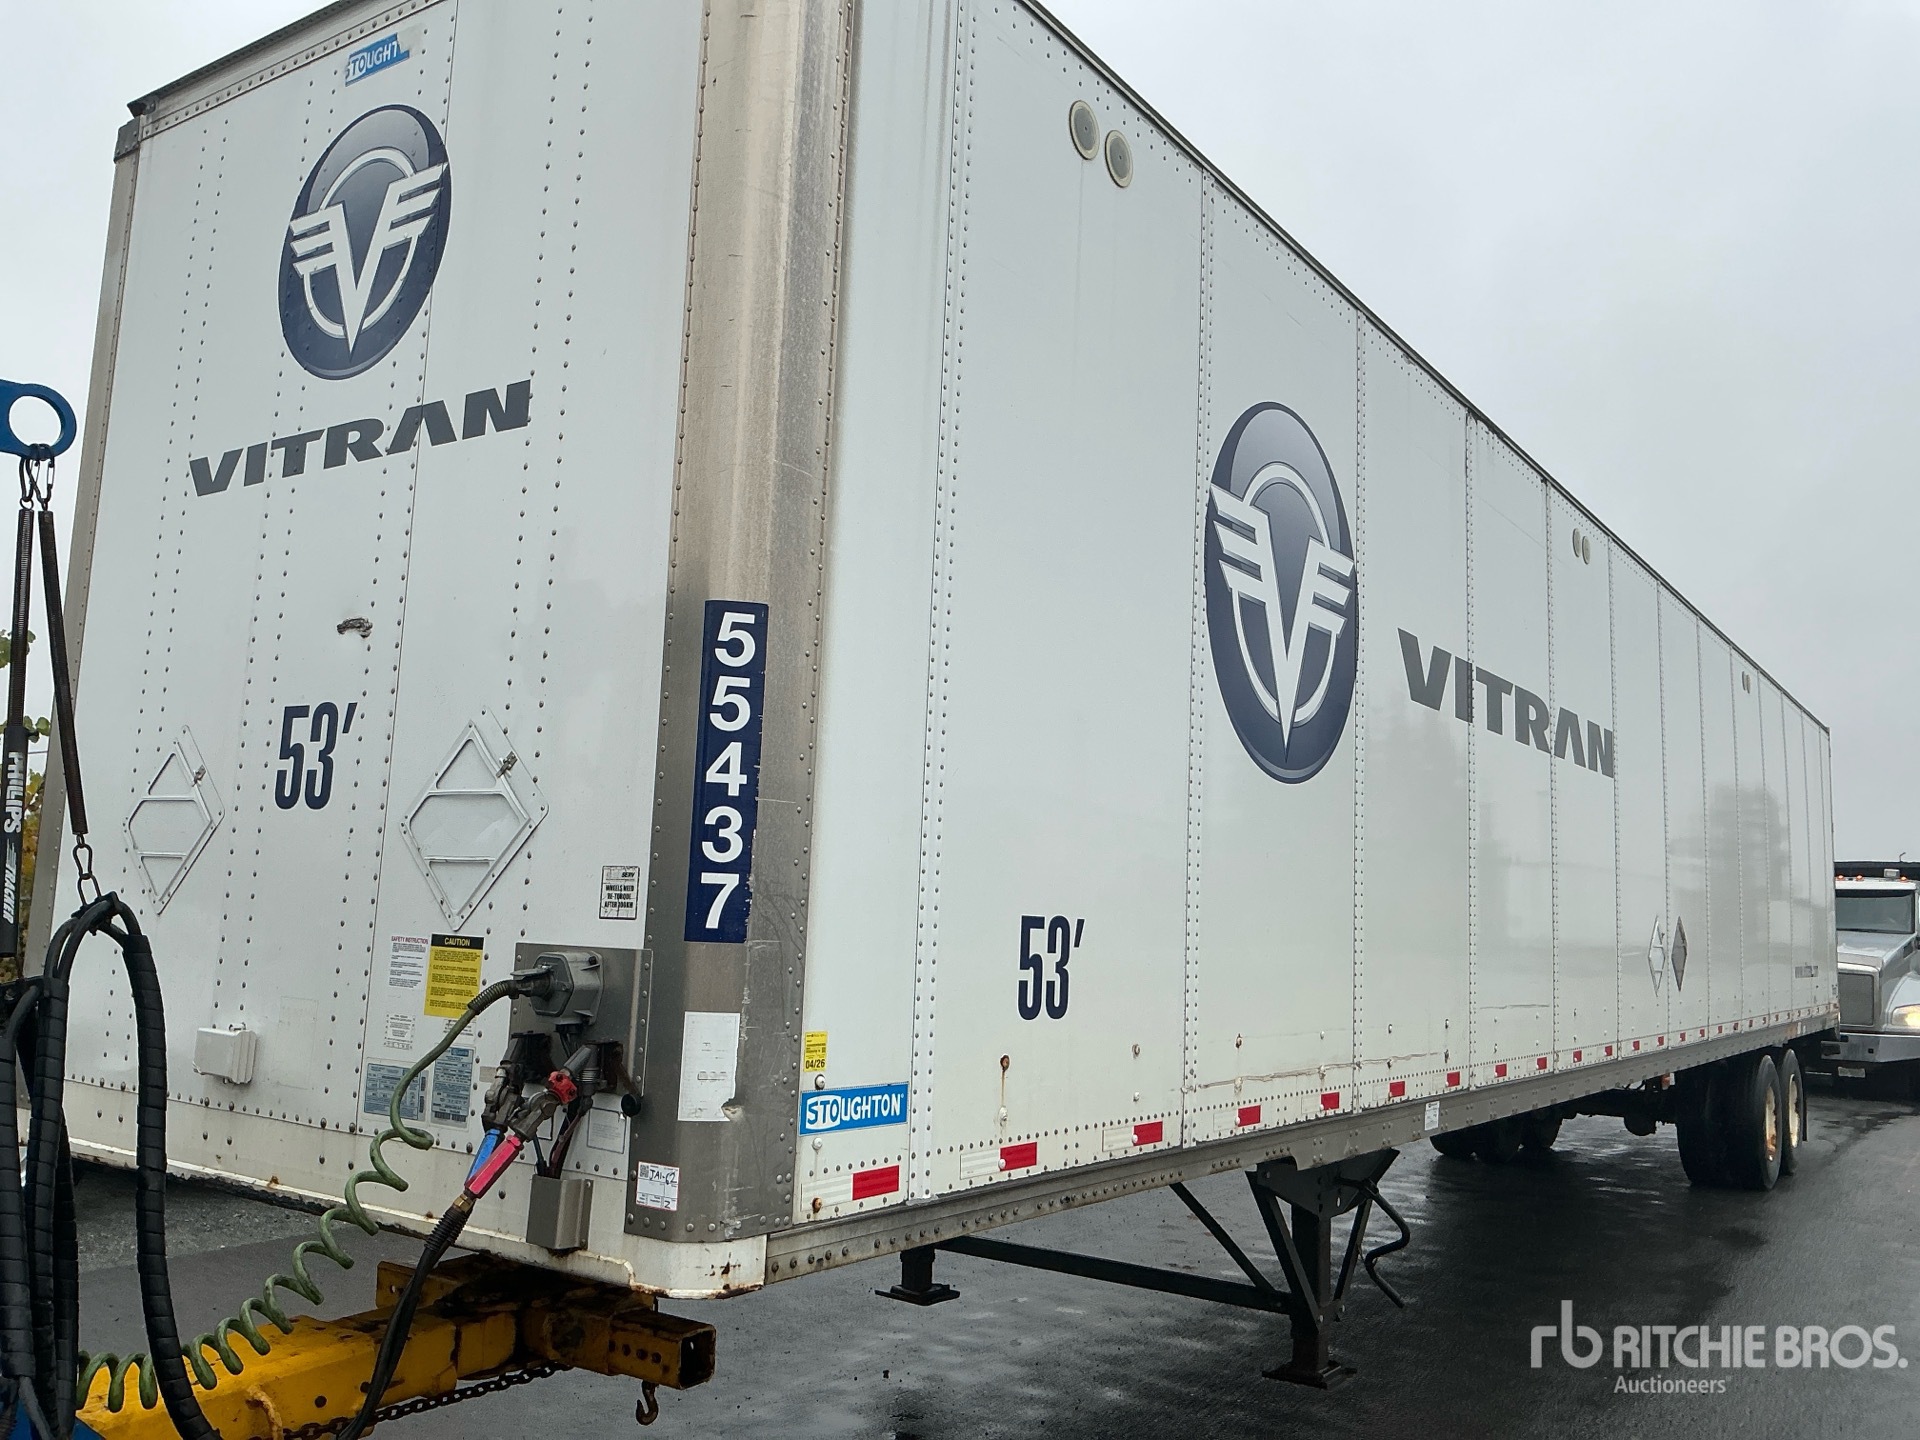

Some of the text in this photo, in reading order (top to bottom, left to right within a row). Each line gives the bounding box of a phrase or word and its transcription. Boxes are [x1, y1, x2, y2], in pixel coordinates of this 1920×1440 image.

[189, 379, 531, 497] VITRAN
[1397, 627, 1615, 779] VITRAN
[4, 751, 24, 834] PHILLIPS
[274, 702, 358, 810] 53'
[700, 611, 757, 930] 55437
[3, 861, 17, 925] TRACKER
[444, 937, 471, 947] CAUTION
[1017, 915, 1085, 1020] 53'
[805, 1059, 826, 1069] 04/26
[807, 1092, 901, 1125] STOUGHTON
